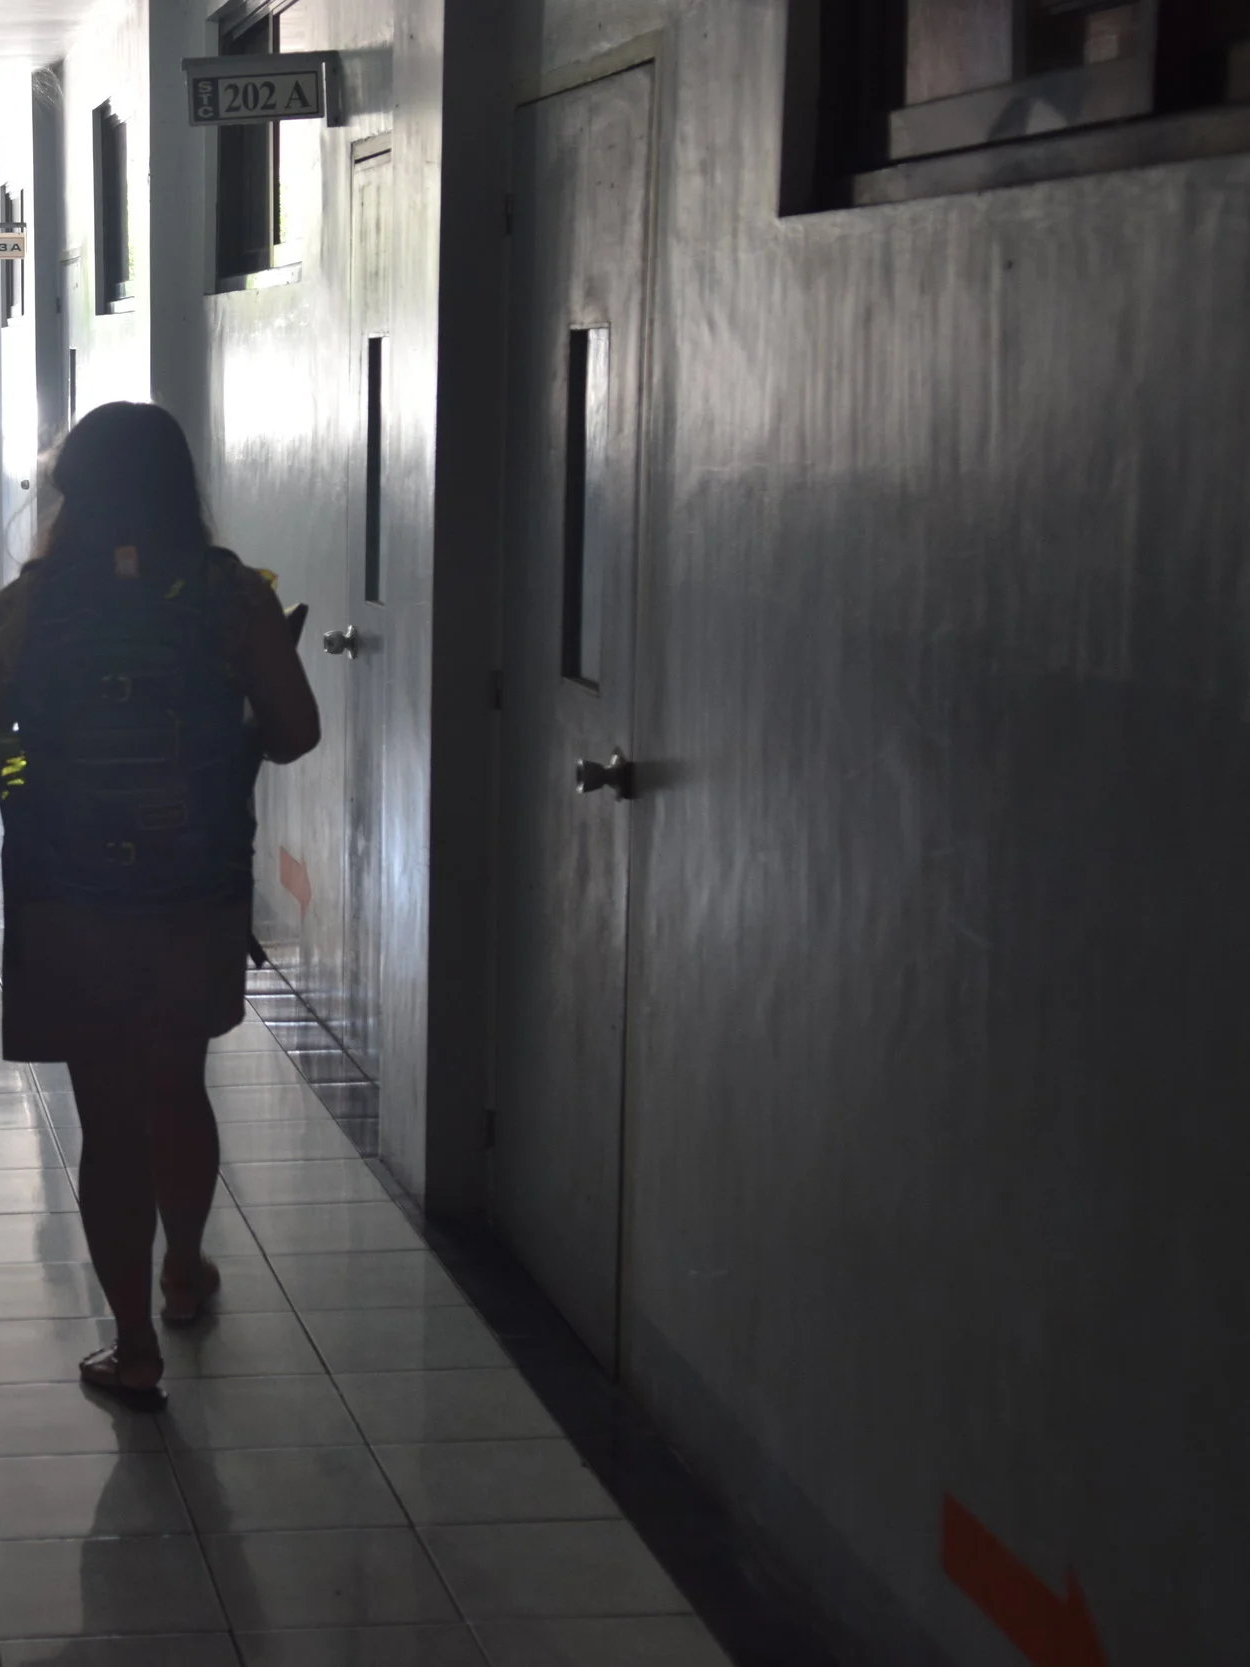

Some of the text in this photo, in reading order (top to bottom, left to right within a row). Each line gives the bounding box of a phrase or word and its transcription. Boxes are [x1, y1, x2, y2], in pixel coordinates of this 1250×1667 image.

[197, 80, 215, 118] STC
[224, 80, 311, 113] 202 A
[10, 243, 22, 252] A
